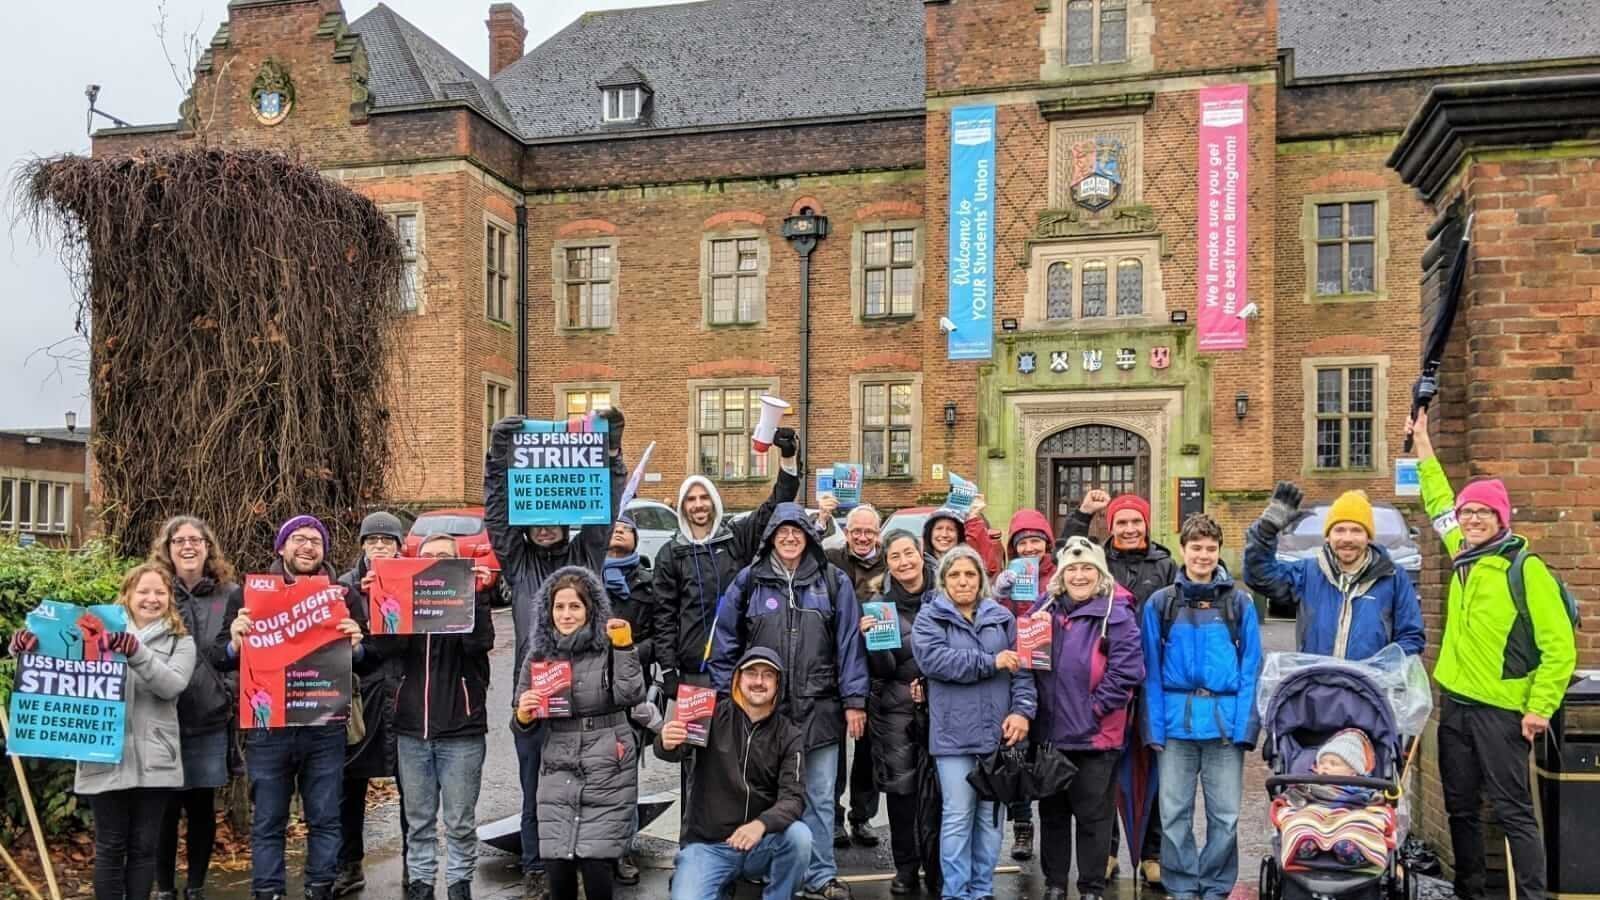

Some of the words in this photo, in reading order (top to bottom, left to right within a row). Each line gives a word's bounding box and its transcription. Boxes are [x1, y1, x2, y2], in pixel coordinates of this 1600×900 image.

[1208, 144, 1222, 166] get
[974, 160, 988, 202] Union
[1209, 170, 1221, 196] you
[1224, 136, 1239, 221] Birmingham!
[955, 199, 971, 215] to
[1209, 199, 1219, 228] sure
[952, 217, 970, 286] Welcome
[973, 207, 987, 274] Students'
[1207, 231, 1219, 271] make
[1223, 225, 1236, 256] from
[1224, 259, 1236, 288] best
[972, 279, 986, 320] YOUR
[1206, 275, 1219, 307] We'll
[1223, 292, 1236, 314] the
[513, 432, 539, 445] USS
[542, 432, 603, 445] PENSION
[513, 446, 604, 468] STRIKE
[514, 474, 532, 484] WE
[536, 474, 585, 484] EARNED
[589, 474, 603, 484] IT.
[514, 487, 532, 497] WE
[535, 487, 587, 497] DESERVE
[590, 487, 603, 497] IT.
[515, 500, 533, 510] WE
[536, 500, 586, 510] DEMAND
[590, 500, 603, 510] IT.
[250, 579, 275, 589] UCU
[249, 630, 284, 648] ONE
[285, 606, 331, 638] VOICE
[23, 654, 53, 669] USS
[56, 658, 123, 675] PENSION
[292, 670, 319, 679] Equality
[19, 669, 122, 700] STRIKE
[305, 680, 332, 688] security
[18, 698, 40, 711] WE
[44, 701, 99, 716] EARNED
[103, 706, 117, 718] IT.
[305, 701, 318, 709] pay
[16, 713, 38, 725] WE
[41, 715, 99, 731] DESERVE
[101, 720, 116, 732] IT.
[15, 727, 36, 740] WE
[40, 730, 96, 744] DEMAND
[100, 735, 115, 747] IT.
